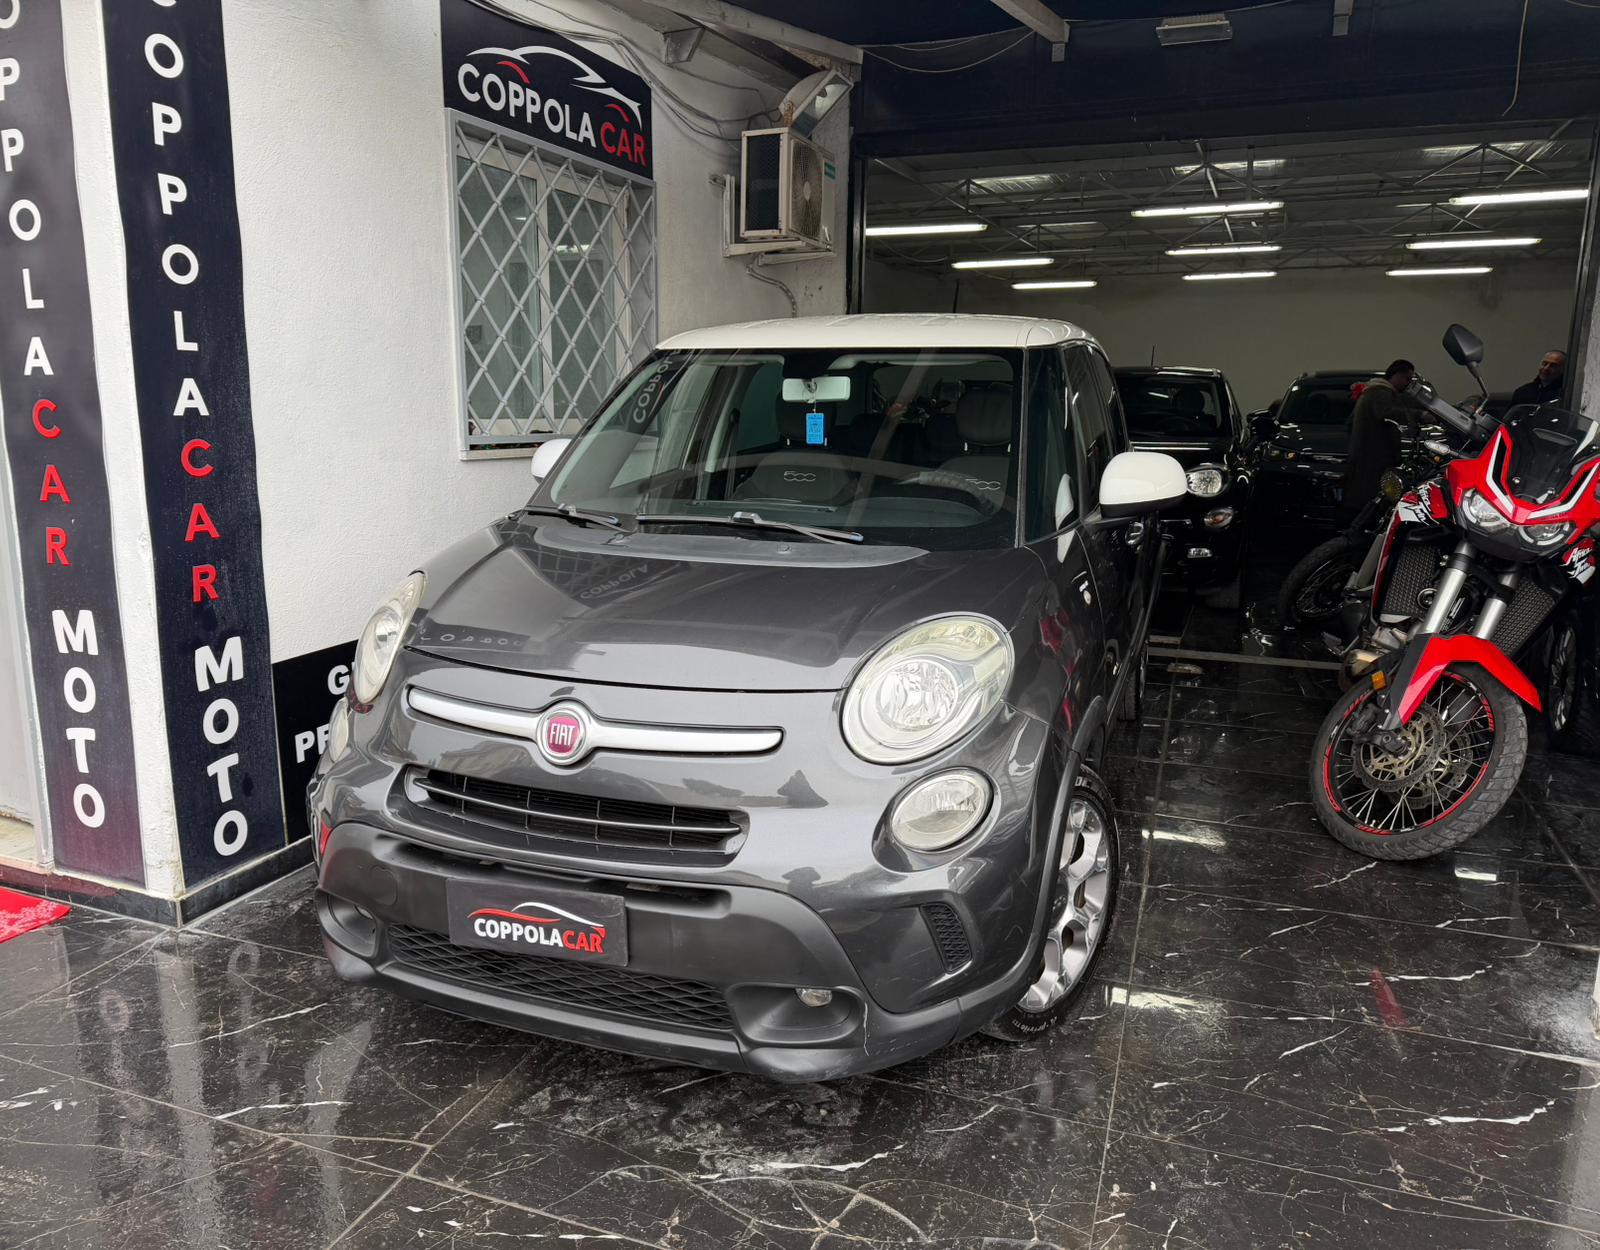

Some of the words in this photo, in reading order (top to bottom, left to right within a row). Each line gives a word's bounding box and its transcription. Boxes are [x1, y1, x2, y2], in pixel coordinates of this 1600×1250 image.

[144, 0, 210, 416] OPPOLA
[194, 636, 249, 857] MOTO
[52, 609, 106, 829] MOTO
[549, 723, 576, 746] FIAT
